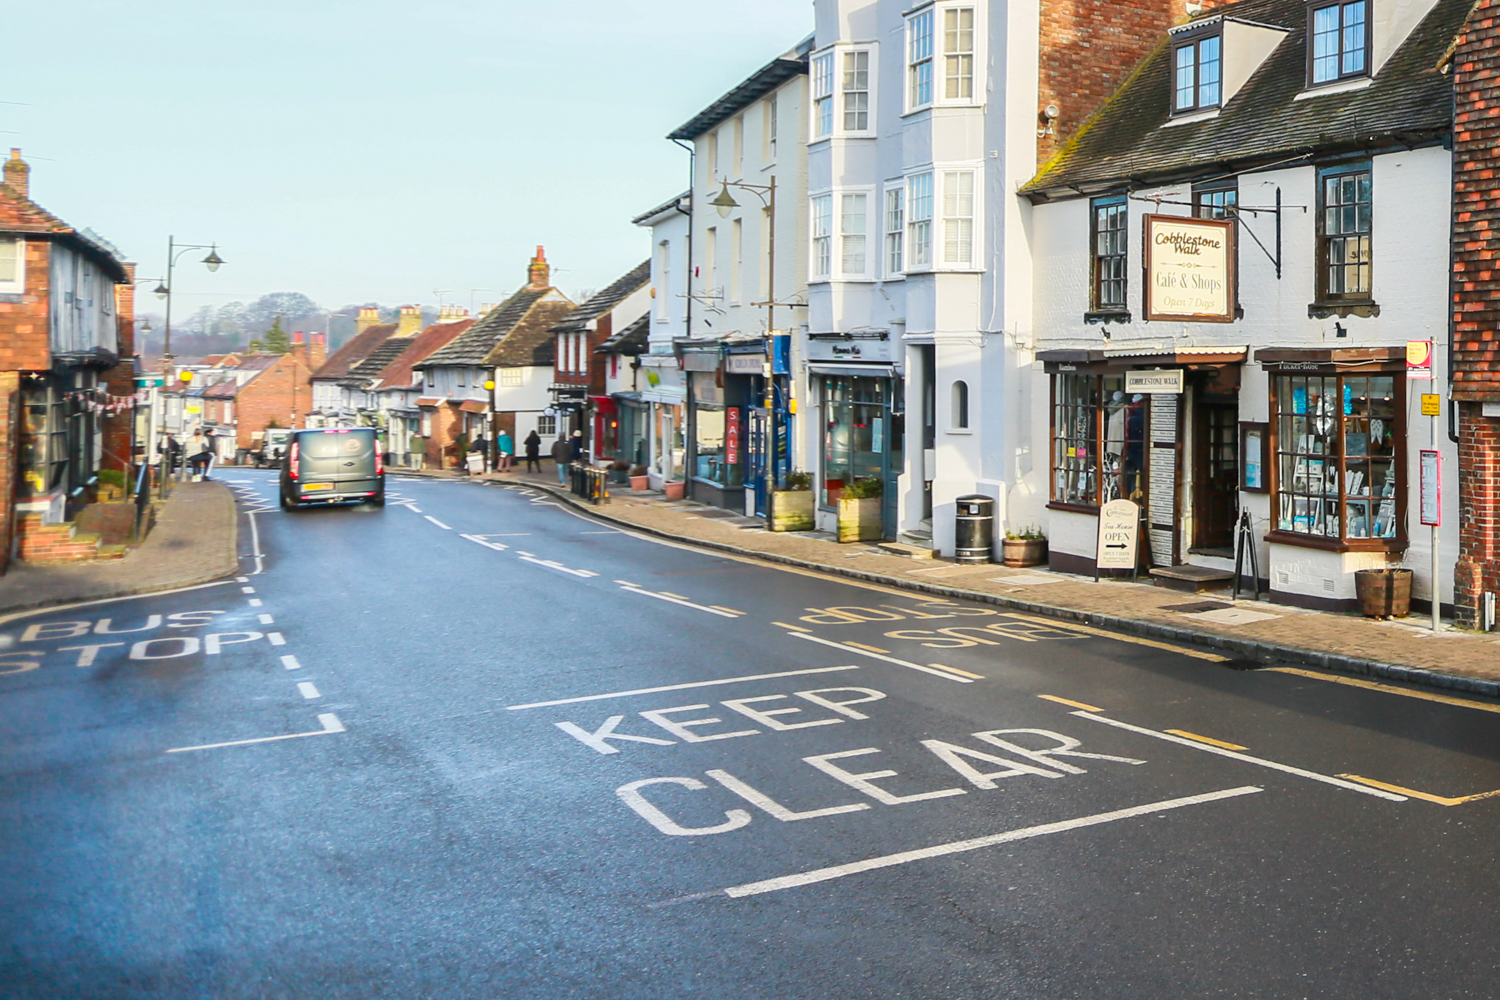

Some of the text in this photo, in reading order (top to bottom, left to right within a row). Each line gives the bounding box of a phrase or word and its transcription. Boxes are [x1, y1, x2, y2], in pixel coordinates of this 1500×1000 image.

[1155, 232, 1222, 249] Cobblestone
[1174, 242, 1202, 255] Walk
[1156, 271, 1222, 294] Café & Shops
[1163, 296, 1215, 310] Open 7 Days
[1129, 378, 1163, 386] COBBLESTONE
[728, 411, 737, 462] SALE
[1104, 532, 1131, 541] OPEN
[800, 602, 998, 624] STOP
[20, 610, 226, 642] BUS
[884, 621, 1092, 648] BUS
[0, 631, 264, 675] STOP
[555, 686, 887, 755] KEEP
[615, 728, 1147, 837] CLEAR
